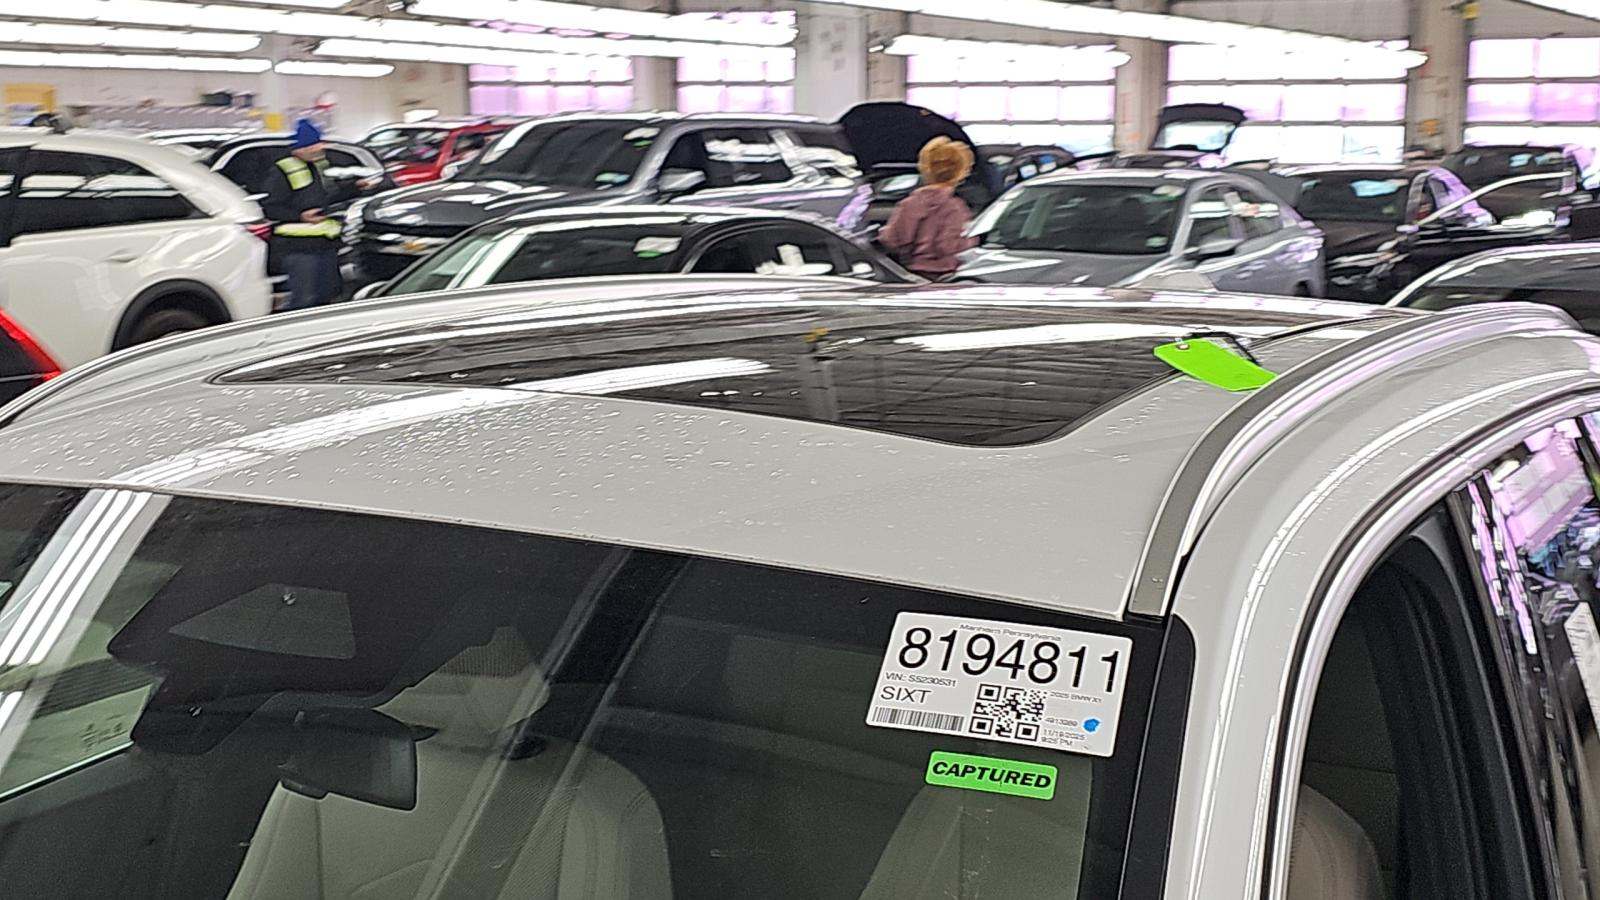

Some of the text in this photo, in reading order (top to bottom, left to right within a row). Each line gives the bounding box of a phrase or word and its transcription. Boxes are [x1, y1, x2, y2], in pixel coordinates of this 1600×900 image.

[898, 627, 1120, 693] 8194811
[885, 672, 907, 681] VIN:
[880, 685, 932, 703] SIXT
[932, 761, 1052, 789] CAPTURED
